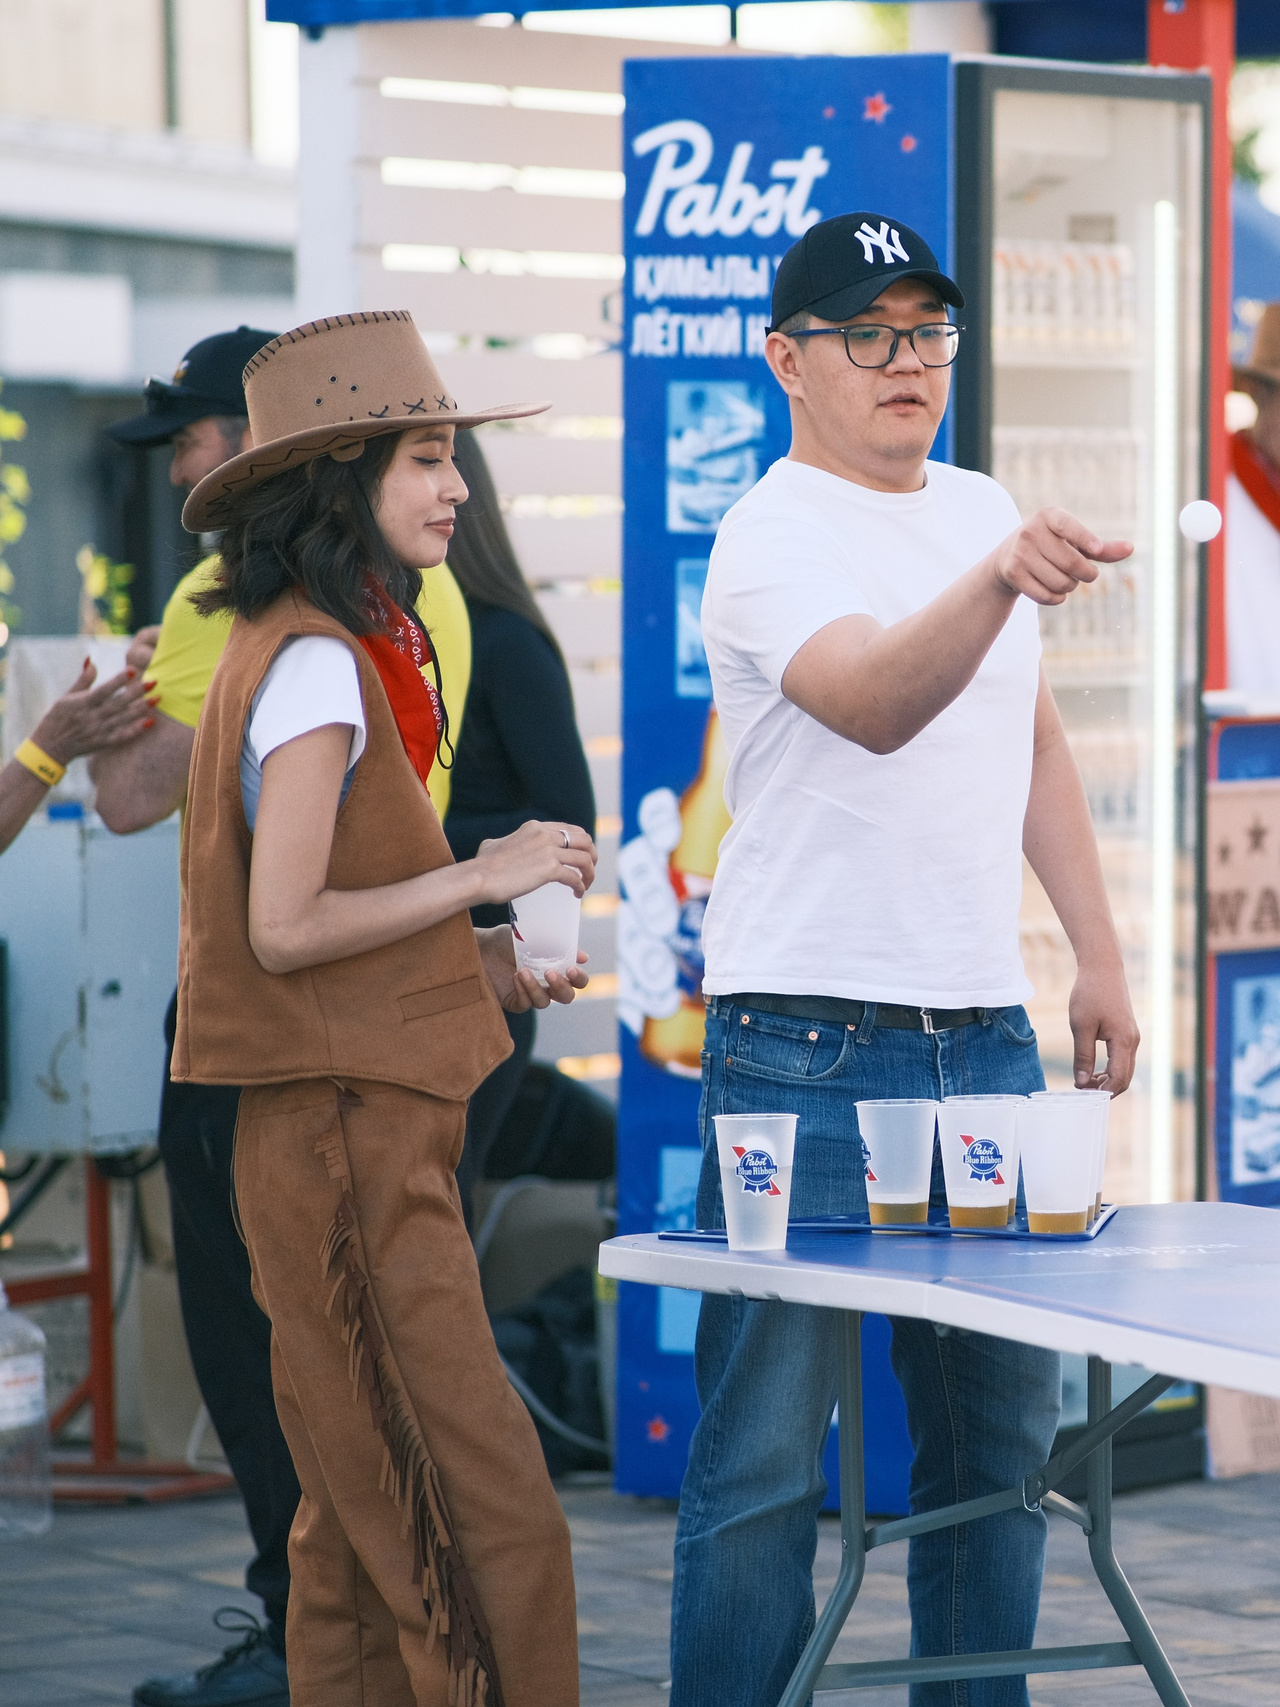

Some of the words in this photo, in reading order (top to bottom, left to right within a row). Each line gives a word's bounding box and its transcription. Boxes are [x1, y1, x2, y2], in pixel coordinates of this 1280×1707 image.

[632, 118, 830, 239] Pabst
[854, 221, 910, 264] NY
[630, 306, 743, 358] ЛЁГКИЙ
[974, 1143, 994, 1155] Pabst
[745, 1154, 767, 1166] Pabst
[965, 1155, 979, 1164] Blue
[980, 1155, 1001, 1164] Ribbon
[738, 1166, 752, 1175] Blue
[752, 1167, 776, 1175] Ribbon
